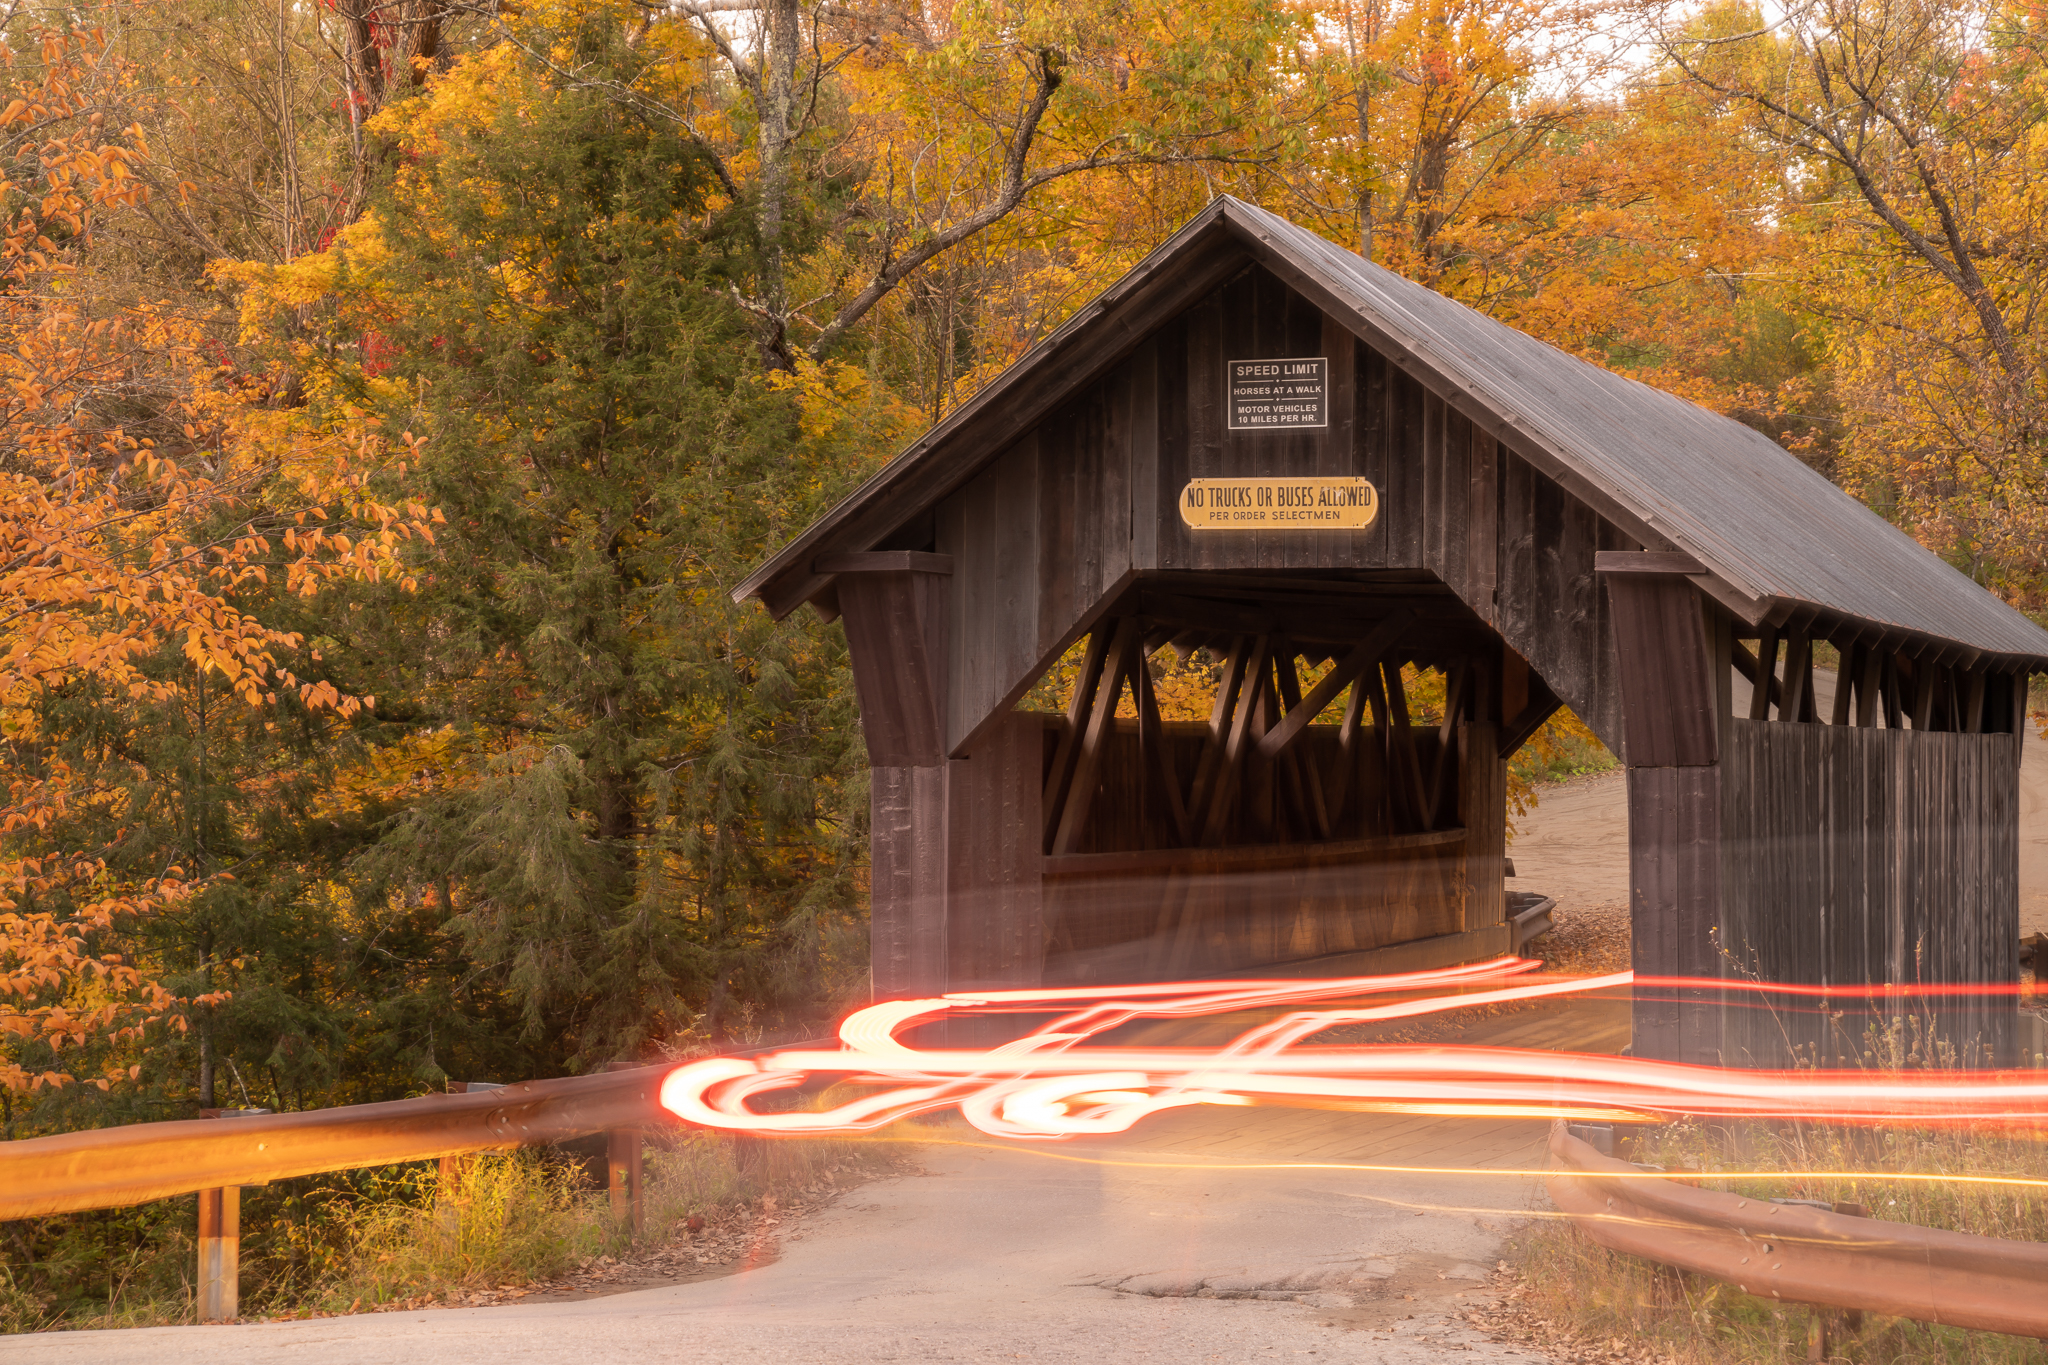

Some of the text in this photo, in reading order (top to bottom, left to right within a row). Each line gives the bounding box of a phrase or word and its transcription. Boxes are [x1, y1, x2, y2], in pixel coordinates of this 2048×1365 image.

[1237, 364, 1318, 376] SPEED LIMIT
[1234, 387, 1270, 395] HORSES
[1187, 486, 1370, 507] NO TRUCKS OR BUSES ALLOWED
[1210, 511, 1340, 520] PER ORDER SELECTMEN
